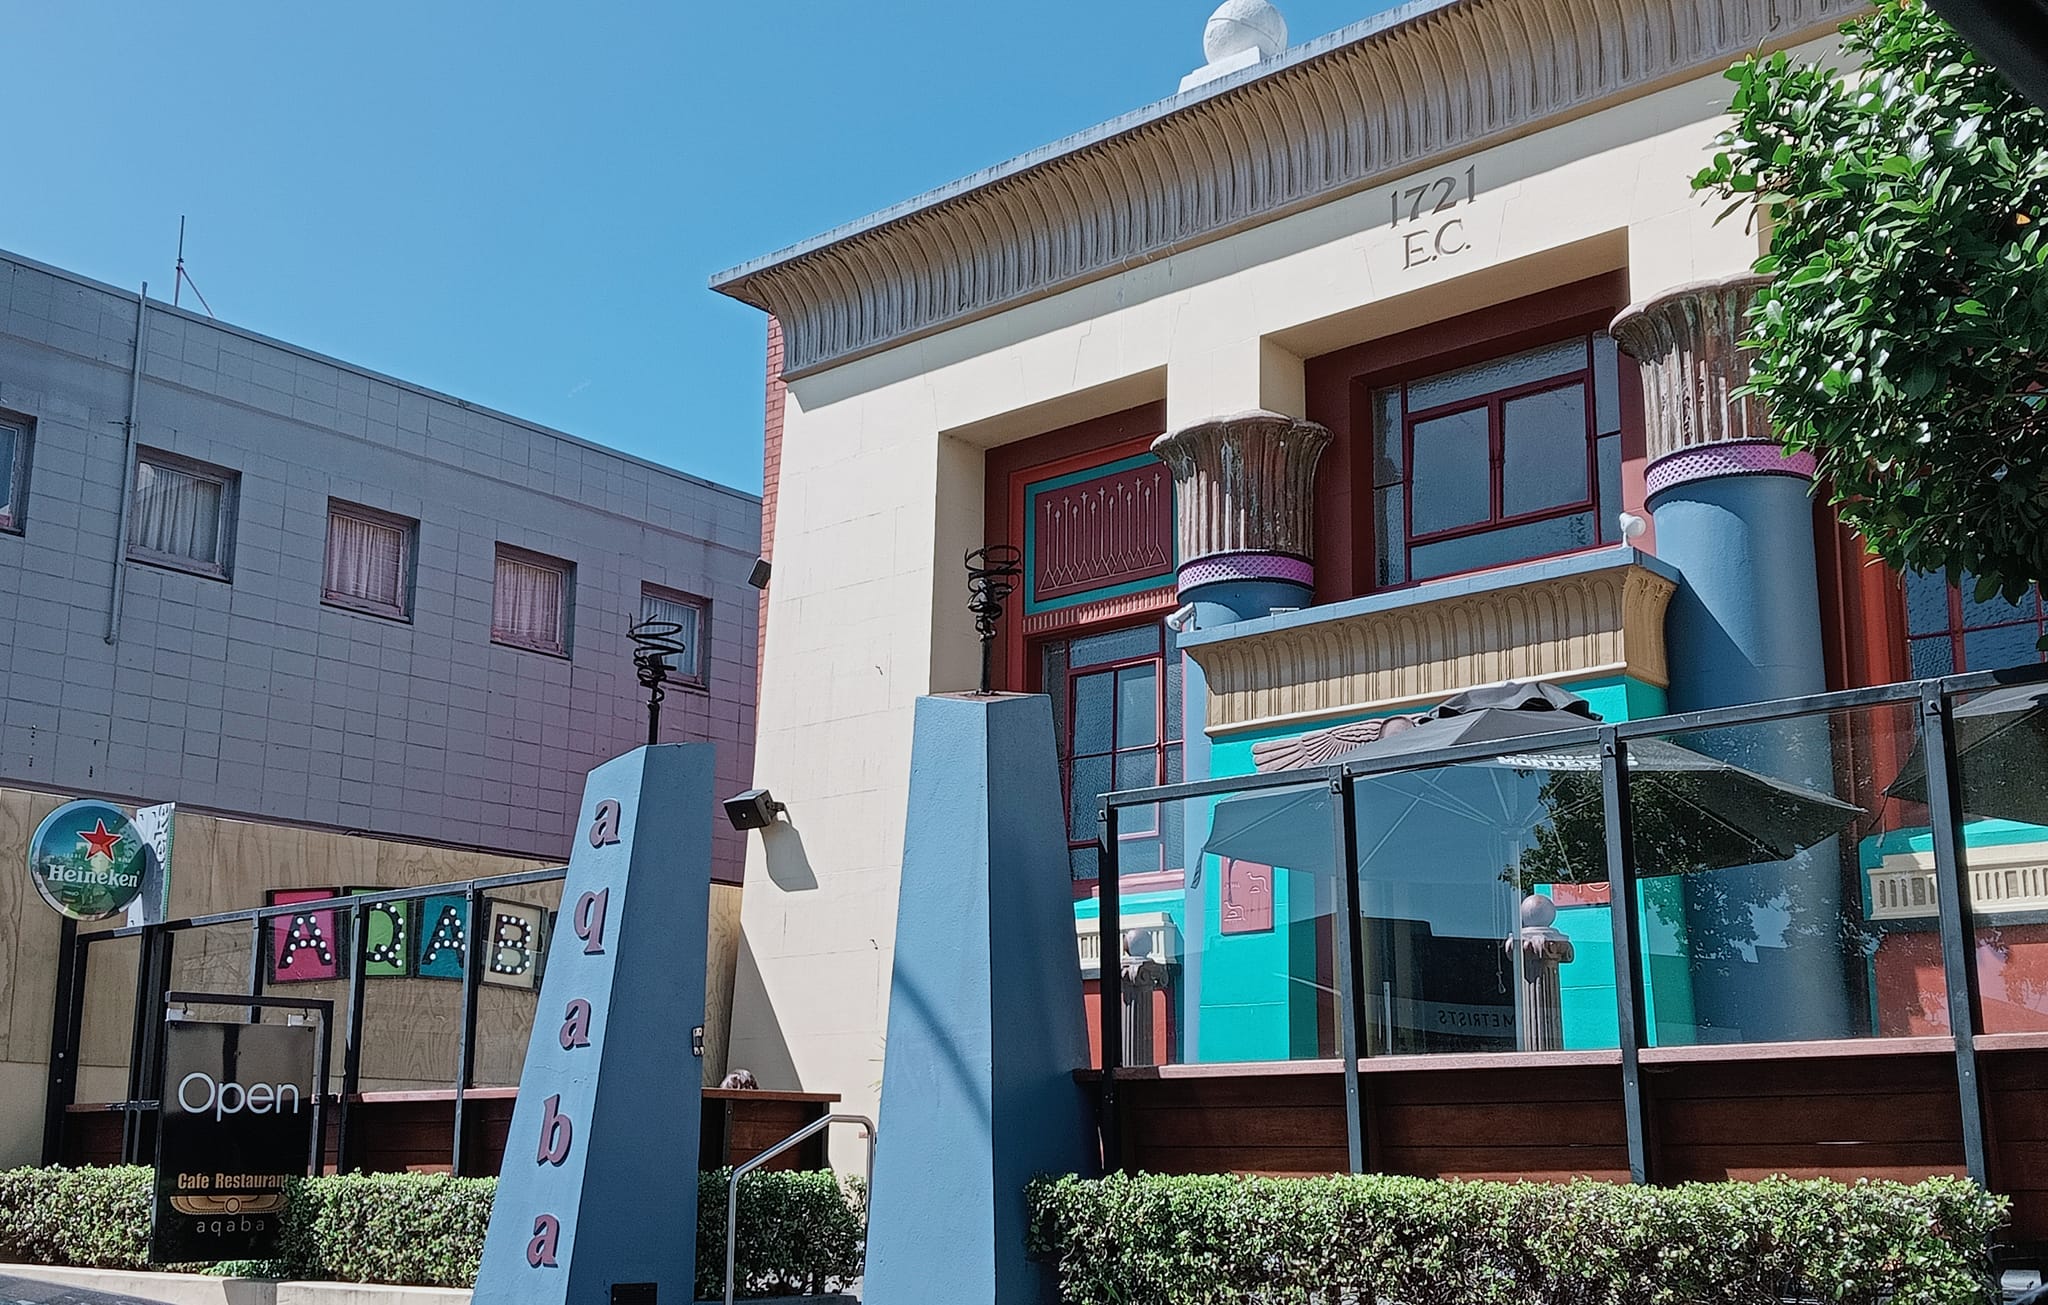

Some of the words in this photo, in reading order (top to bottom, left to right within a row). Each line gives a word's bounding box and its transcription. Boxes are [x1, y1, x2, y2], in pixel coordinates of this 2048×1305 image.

[1390, 163, 1476, 229] 1721
[1402, 218, 1471, 270] E.C.
[47, 864, 139, 888] Heineken
[526, 796, 621, 1269] aqaba
[178, 1072, 299, 1122] Open
[177, 1173, 210, 1189] Cafe
[196, 1215, 265, 1237] aqaba
